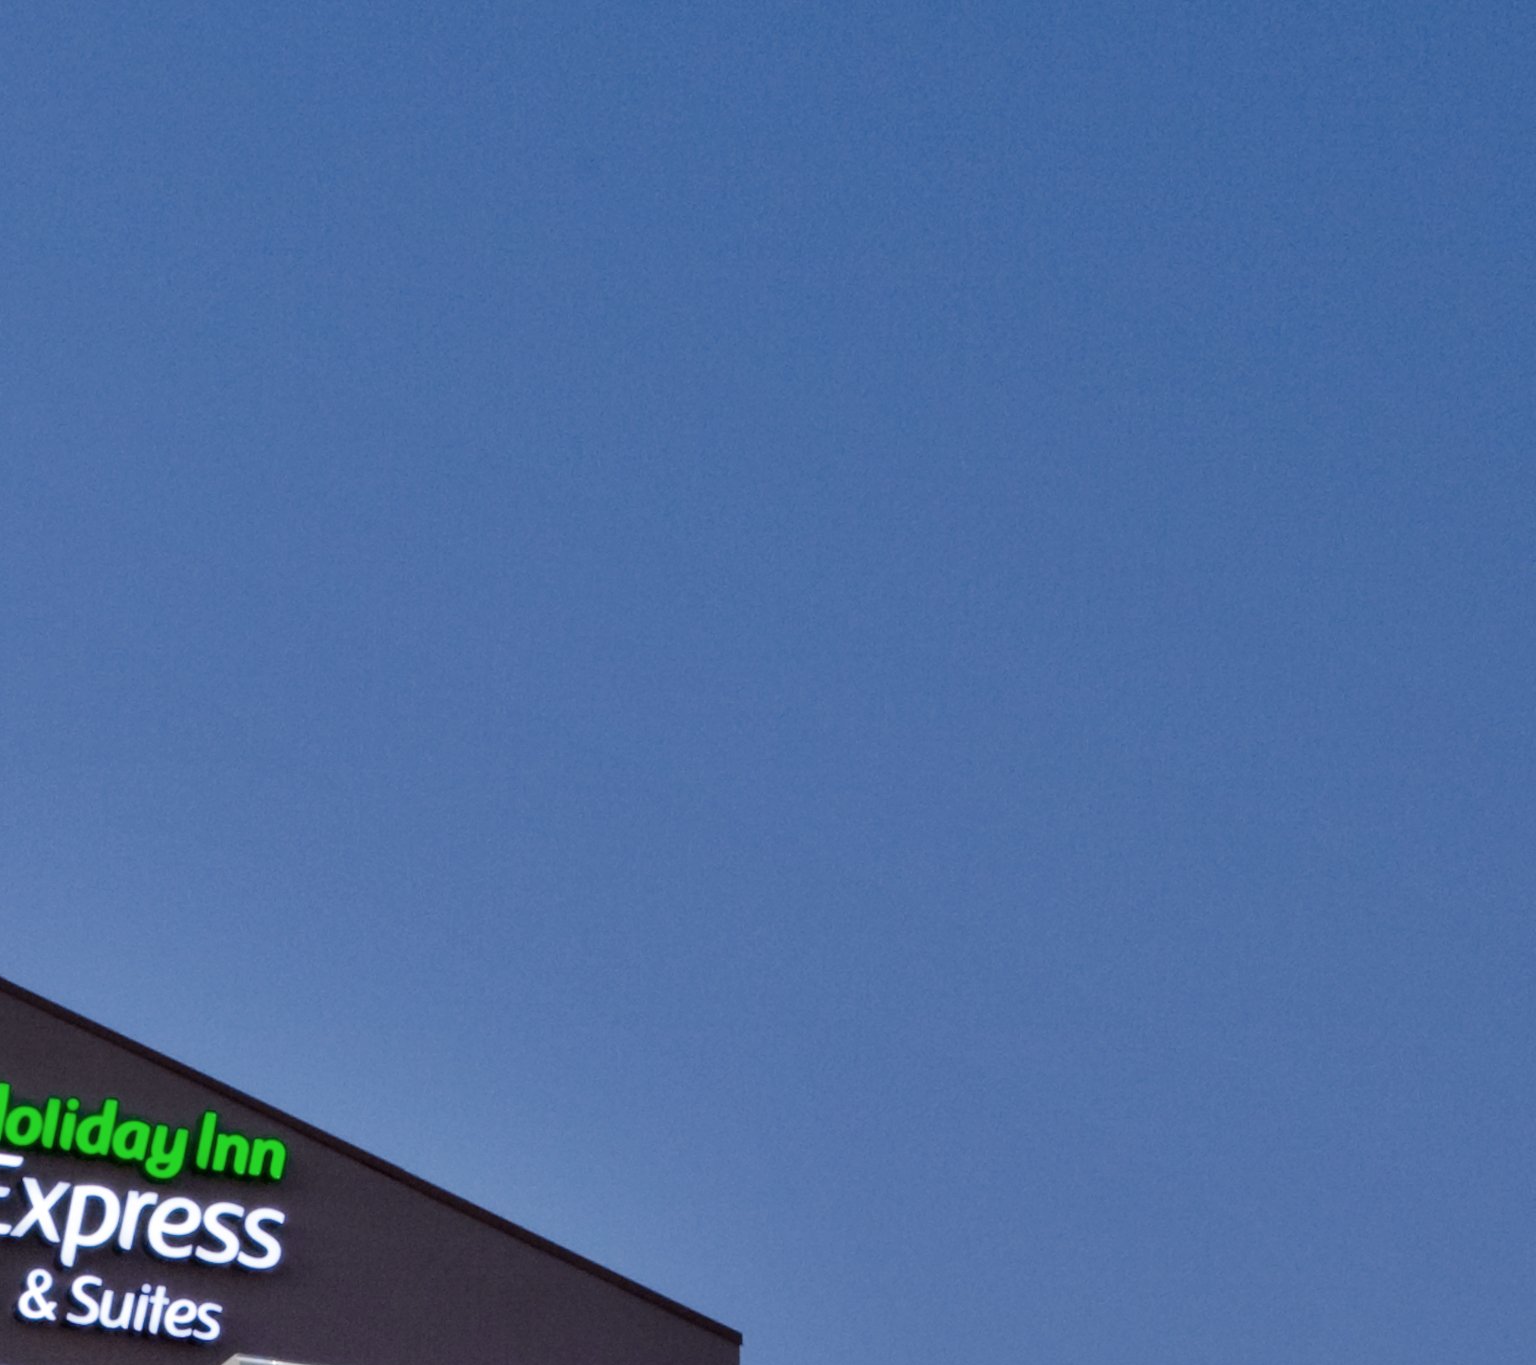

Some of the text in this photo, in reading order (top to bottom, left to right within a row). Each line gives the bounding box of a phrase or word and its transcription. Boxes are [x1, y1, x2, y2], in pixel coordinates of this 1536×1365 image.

[199, 1111, 287, 1181] Inn
[18, 1269, 223, 1344] & Suites
